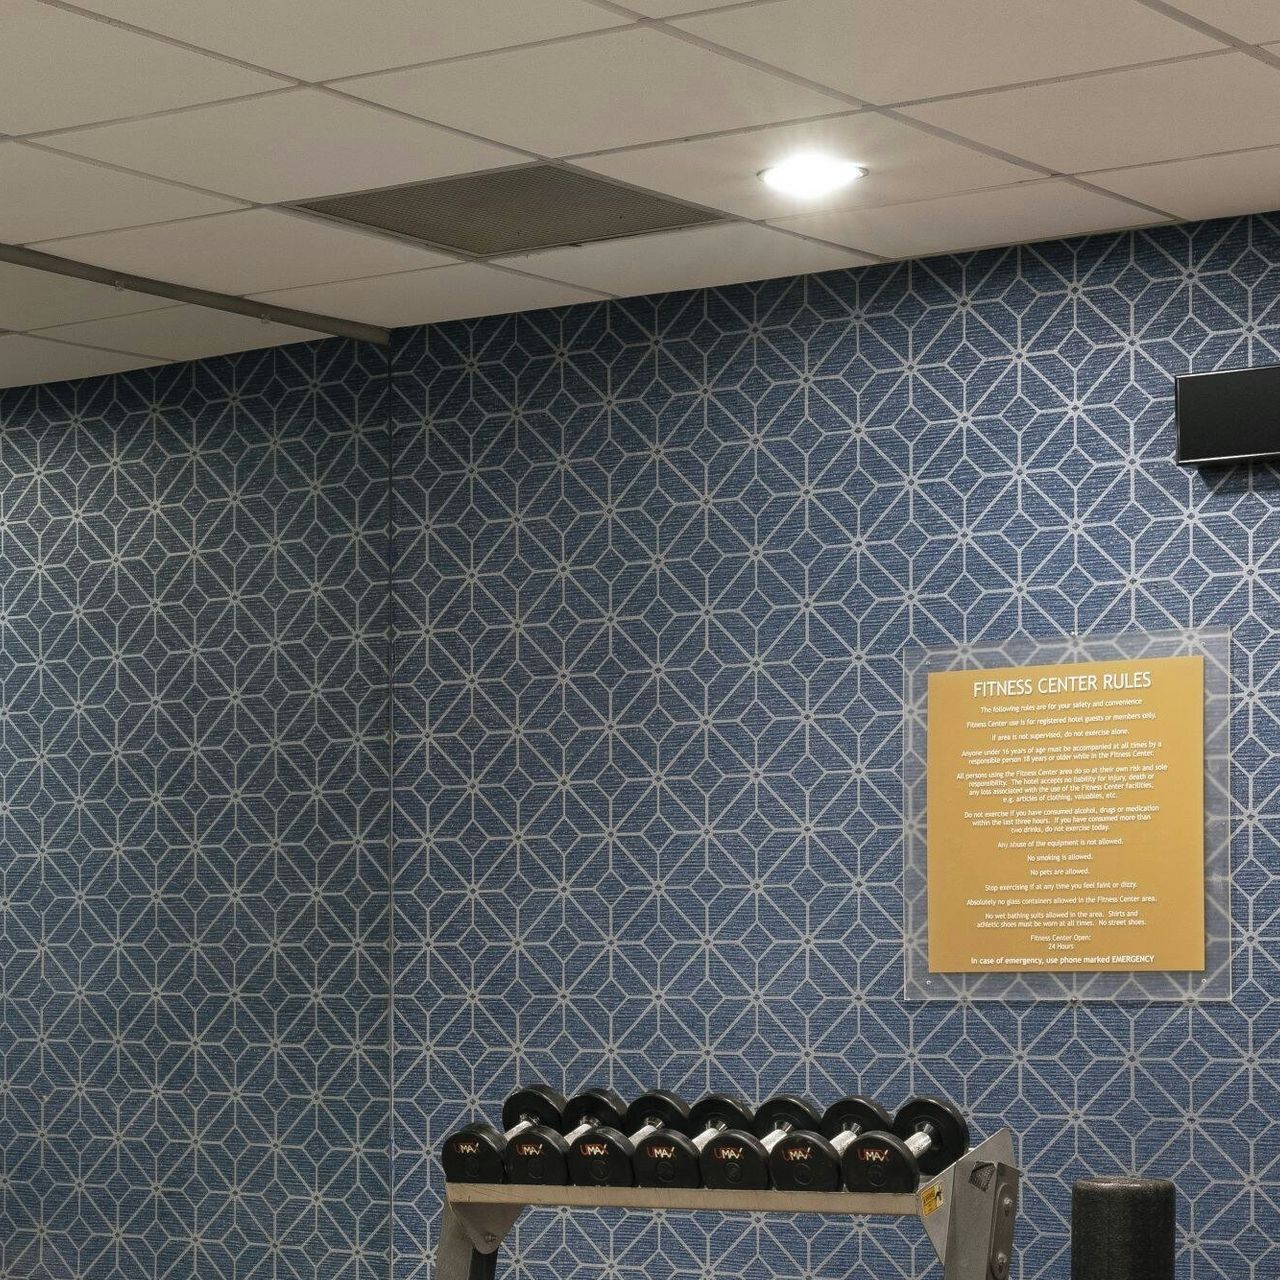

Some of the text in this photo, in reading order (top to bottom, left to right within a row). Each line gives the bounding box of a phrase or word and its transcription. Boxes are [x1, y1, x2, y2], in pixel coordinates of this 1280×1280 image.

[974, 673, 1151, 696] FITNESS CENTER RULES
[992, 704, 1019, 713] following
[1072, 701, 1091, 710] safety
[1104, 698, 1141, 706] convenience
[966, 719, 986, 727] Fitness
[987, 718, 1007, 726] Center
[1020, 717, 1025, 725] is
[1036, 715, 1066, 726] registered
[1068, 715, 1083, 723] hotel
[1084, 714, 1104, 724] guests
[1112, 712, 1140, 721] members
[1084, 728, 1109, 736] exercise
[1036, 853, 1060, 862] smoking
[1039, 868, 1052, 876] pets
[967, 897, 995, 907] Absolutely
[1006, 897, 1020, 906] glass
[1022, 896, 1052, 904] containers
[1119, 894, 1140, 902] Center
[971, 956, 977, 964] In
[1059, 956, 1081, 964] phone
[1083, 955, 1110, 963] marked
[454, 1142, 480, 1154] UMAX
[516, 1143, 543, 1156] UMAX
[580, 1144, 608, 1156] UMAX
[648, 1146, 676, 1160] UMAX
[714, 1147, 744, 1160] UMAX
[782, 1147, 812, 1162] UMAX
[858, 1148, 889, 1162] UMAX
